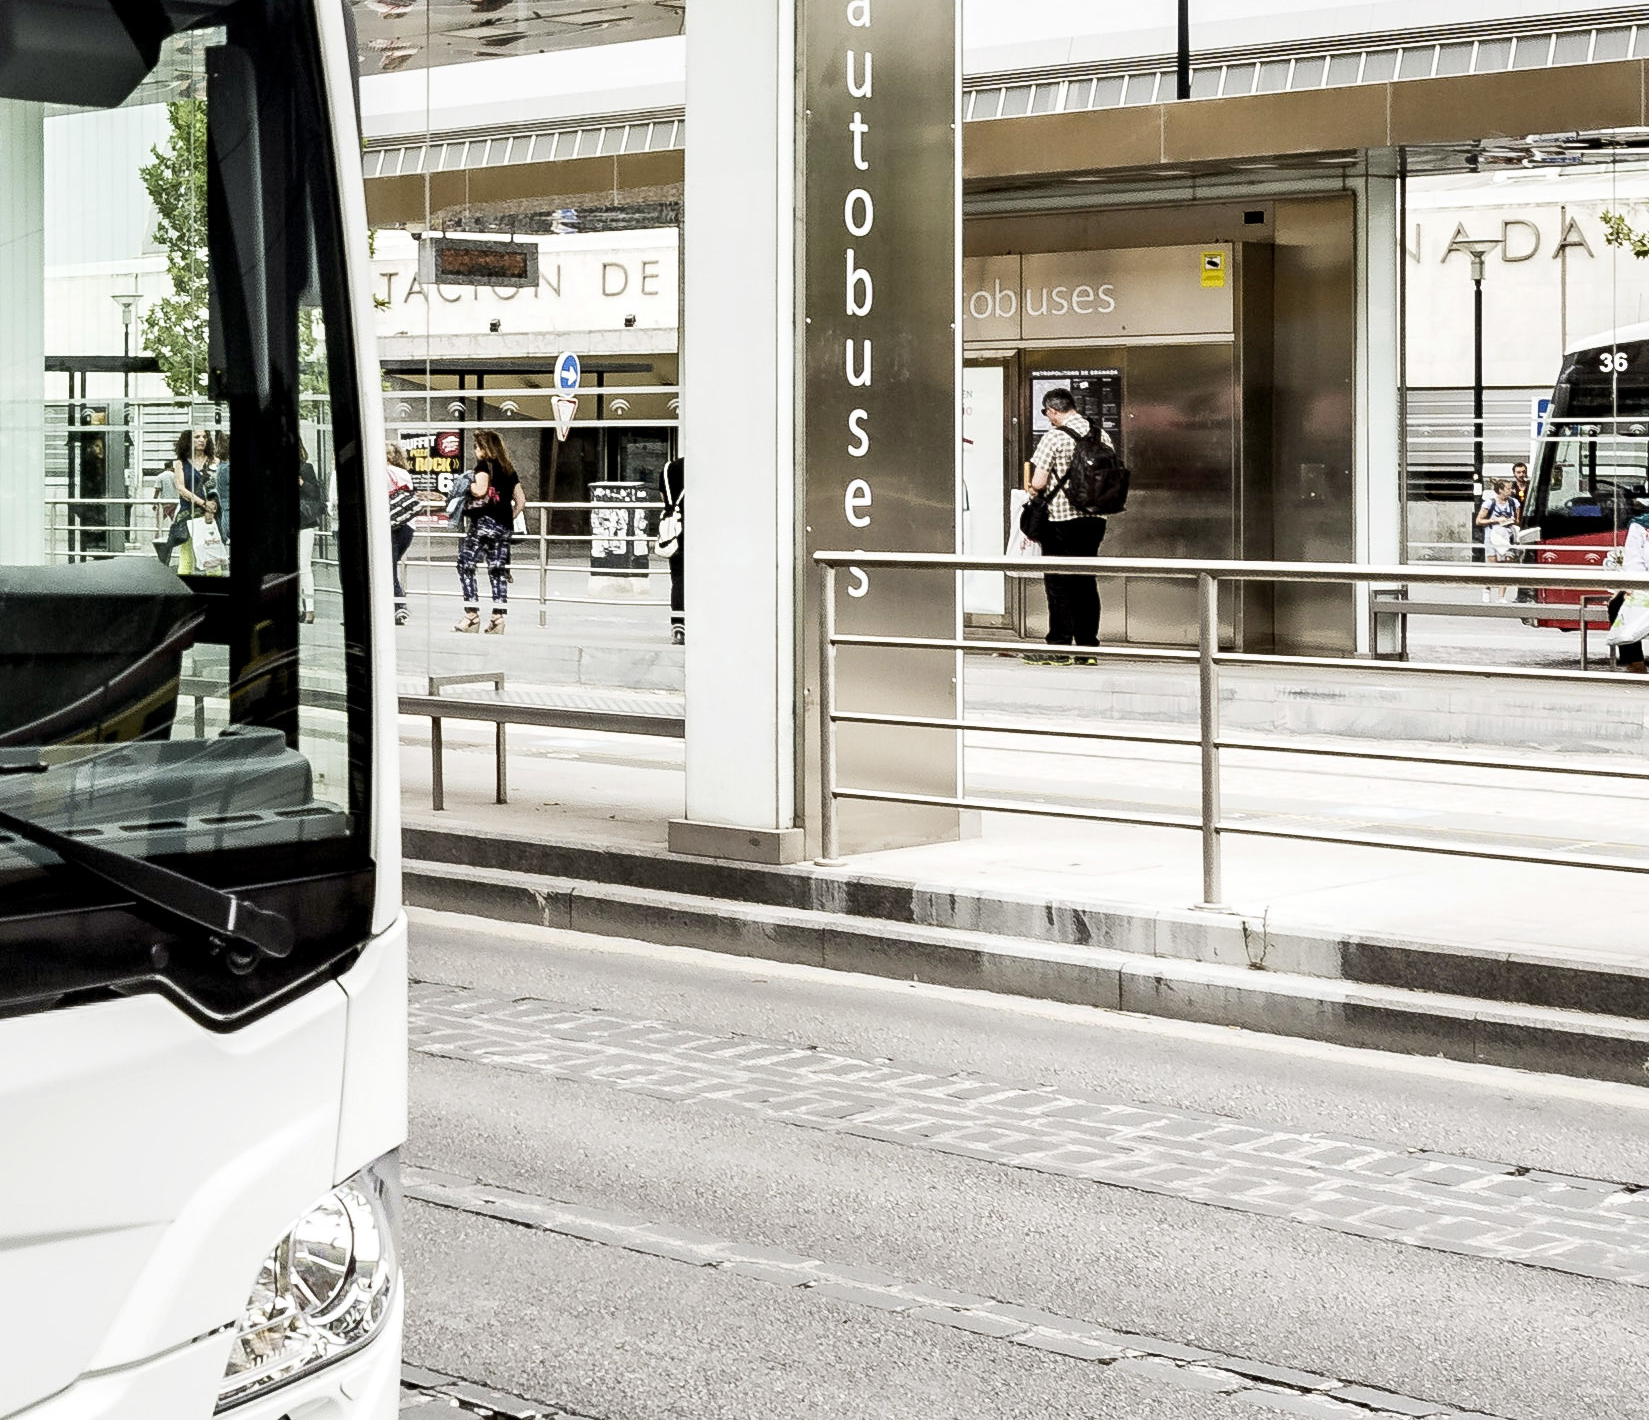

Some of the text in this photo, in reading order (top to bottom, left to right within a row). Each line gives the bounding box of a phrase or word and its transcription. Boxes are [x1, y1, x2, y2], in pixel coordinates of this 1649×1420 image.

[602, 260, 660, 298] DE
[963, 278, 1116, 319] obuses
[1599, 352, 1628, 373] 36
